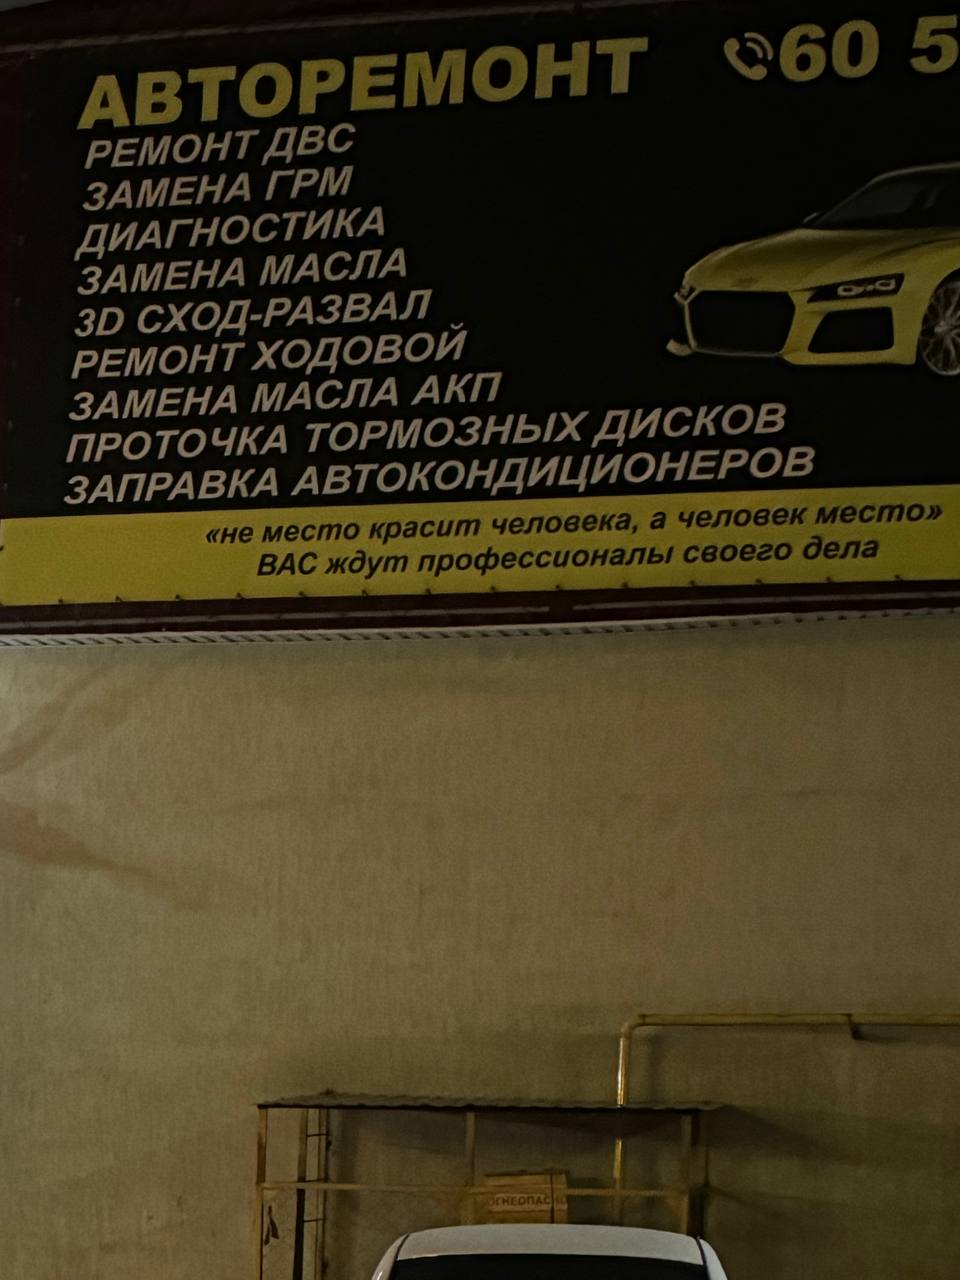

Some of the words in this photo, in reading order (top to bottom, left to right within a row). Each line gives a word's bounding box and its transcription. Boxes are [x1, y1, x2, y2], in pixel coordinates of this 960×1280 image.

[779, 20, 879, 82] 60
[910, 14, 960, 74] 5
[77, 37, 648, 131] АВТОРЕМОНТ
[84, 129, 260, 170] РЕМОНТ
[261, 122, 357, 166] ДВС
[82, 172, 251, 211] ЗАМЕНА
[265, 165, 354, 201] ГРМ
[74, 206, 385, 262] ДИАГНОСТИКА
[77, 257, 246, 296] ЗАМЕНА
[259, 247, 408, 286] МАСЛА
[74, 306, 125, 338] 3D
[136, 288, 433, 338] СХОД-РАЗВАЛ
[71, 341, 246, 380] РЕМОНТ
[250, 322, 469, 375] ХОДОВОЙ
[68, 384, 238, 421] ЗАМЕНА
[250, 376, 399, 413] МАСЛА
[410, 371, 503, 406] АКП
[65, 424, 288, 463] ПРОТОЧКА
[304, 410, 589, 453] ТОРМОЗНЫХ
[591, 402, 786, 448] ДИСКОВ
[63, 467, 279, 505] ЗАПРАВКА
[290, 446, 816, 497] АВТОКОНДИЦИОНЕРОВ
[205, 522, 254, 544] «не
[261, 520, 361, 543] место
[368, 516, 481, 545] красит
[491, 511, 639, 535] человека,
[649, 510, 668, 530] а
[678, 504, 807, 529] человек
[814, 501, 944, 525] место»
[256, 551, 318, 577] ВАС
[324, 549, 409, 580] ждут
[417, 545, 674, 578] профессионалы
[682, 539, 793, 565] своего
[802, 534, 881, 561] дела
